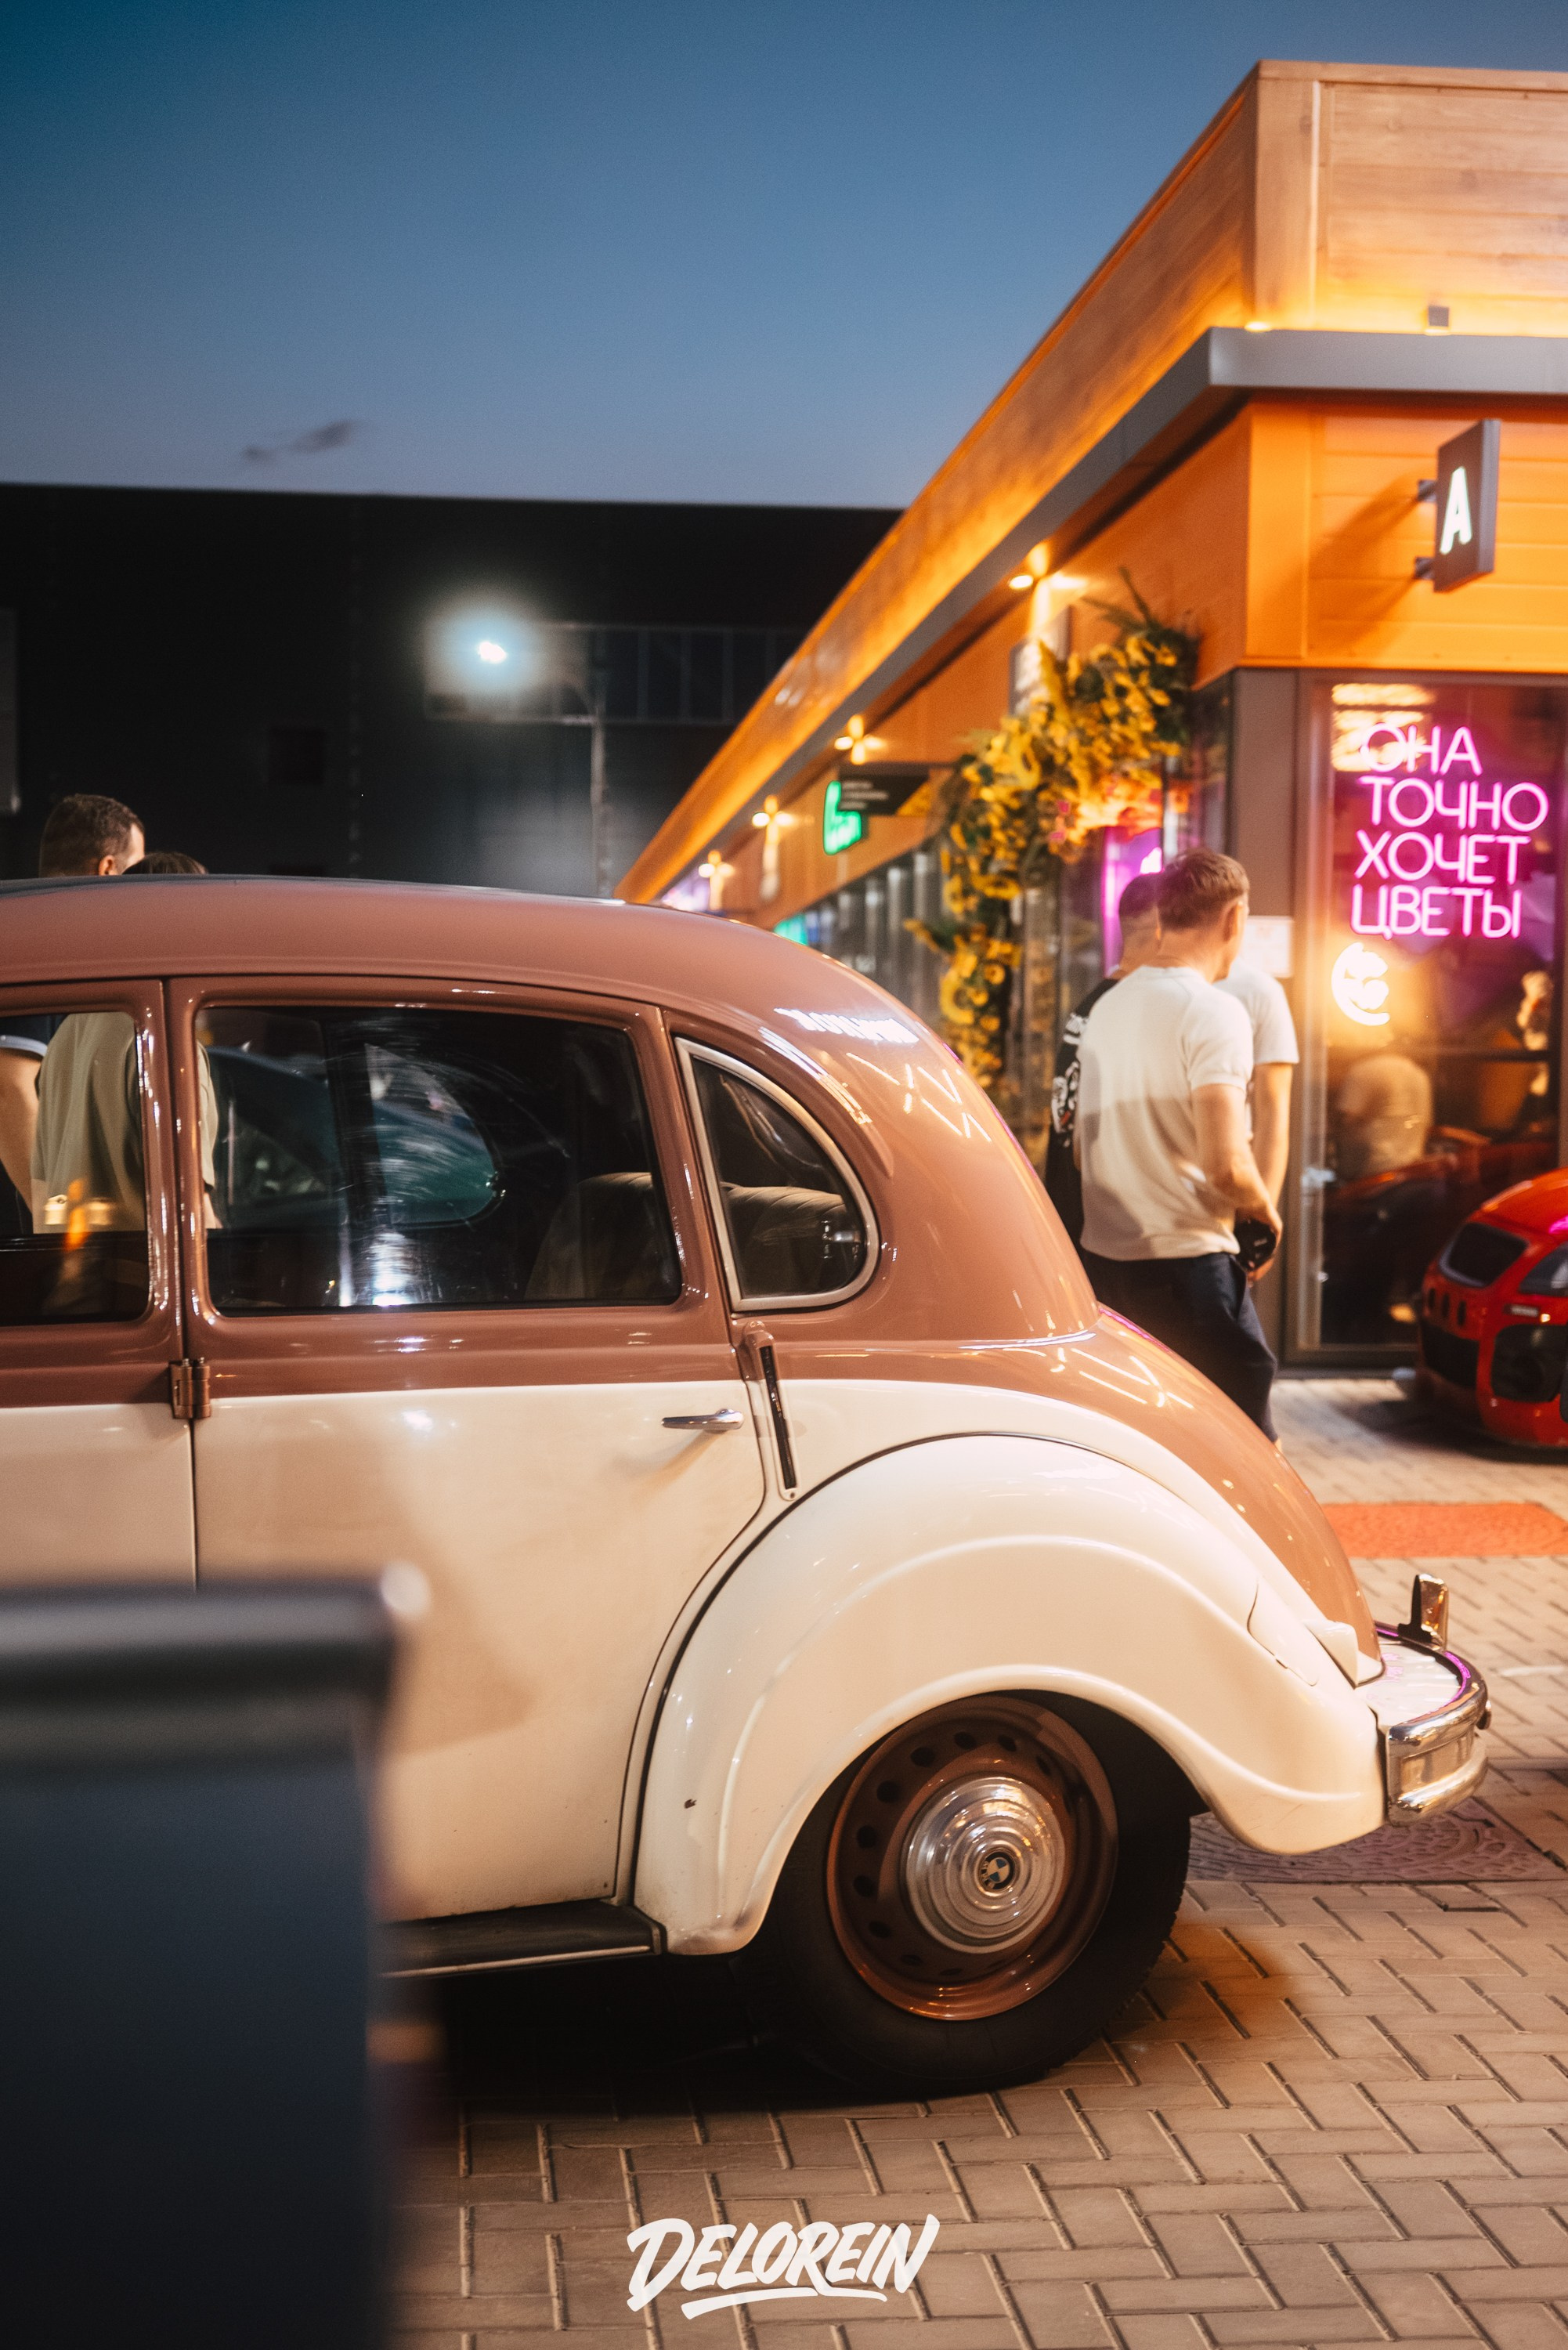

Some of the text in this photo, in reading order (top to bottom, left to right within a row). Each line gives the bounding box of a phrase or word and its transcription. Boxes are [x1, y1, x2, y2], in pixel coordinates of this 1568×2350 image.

[1360, 722, 1483, 776] ОНА
[1357, 776, 1548, 832] ТОЧНО
[1354, 830, 1532, 885] ХОЧЕТ
[1350, 883, 1523, 940] ЦВЕТЫ
